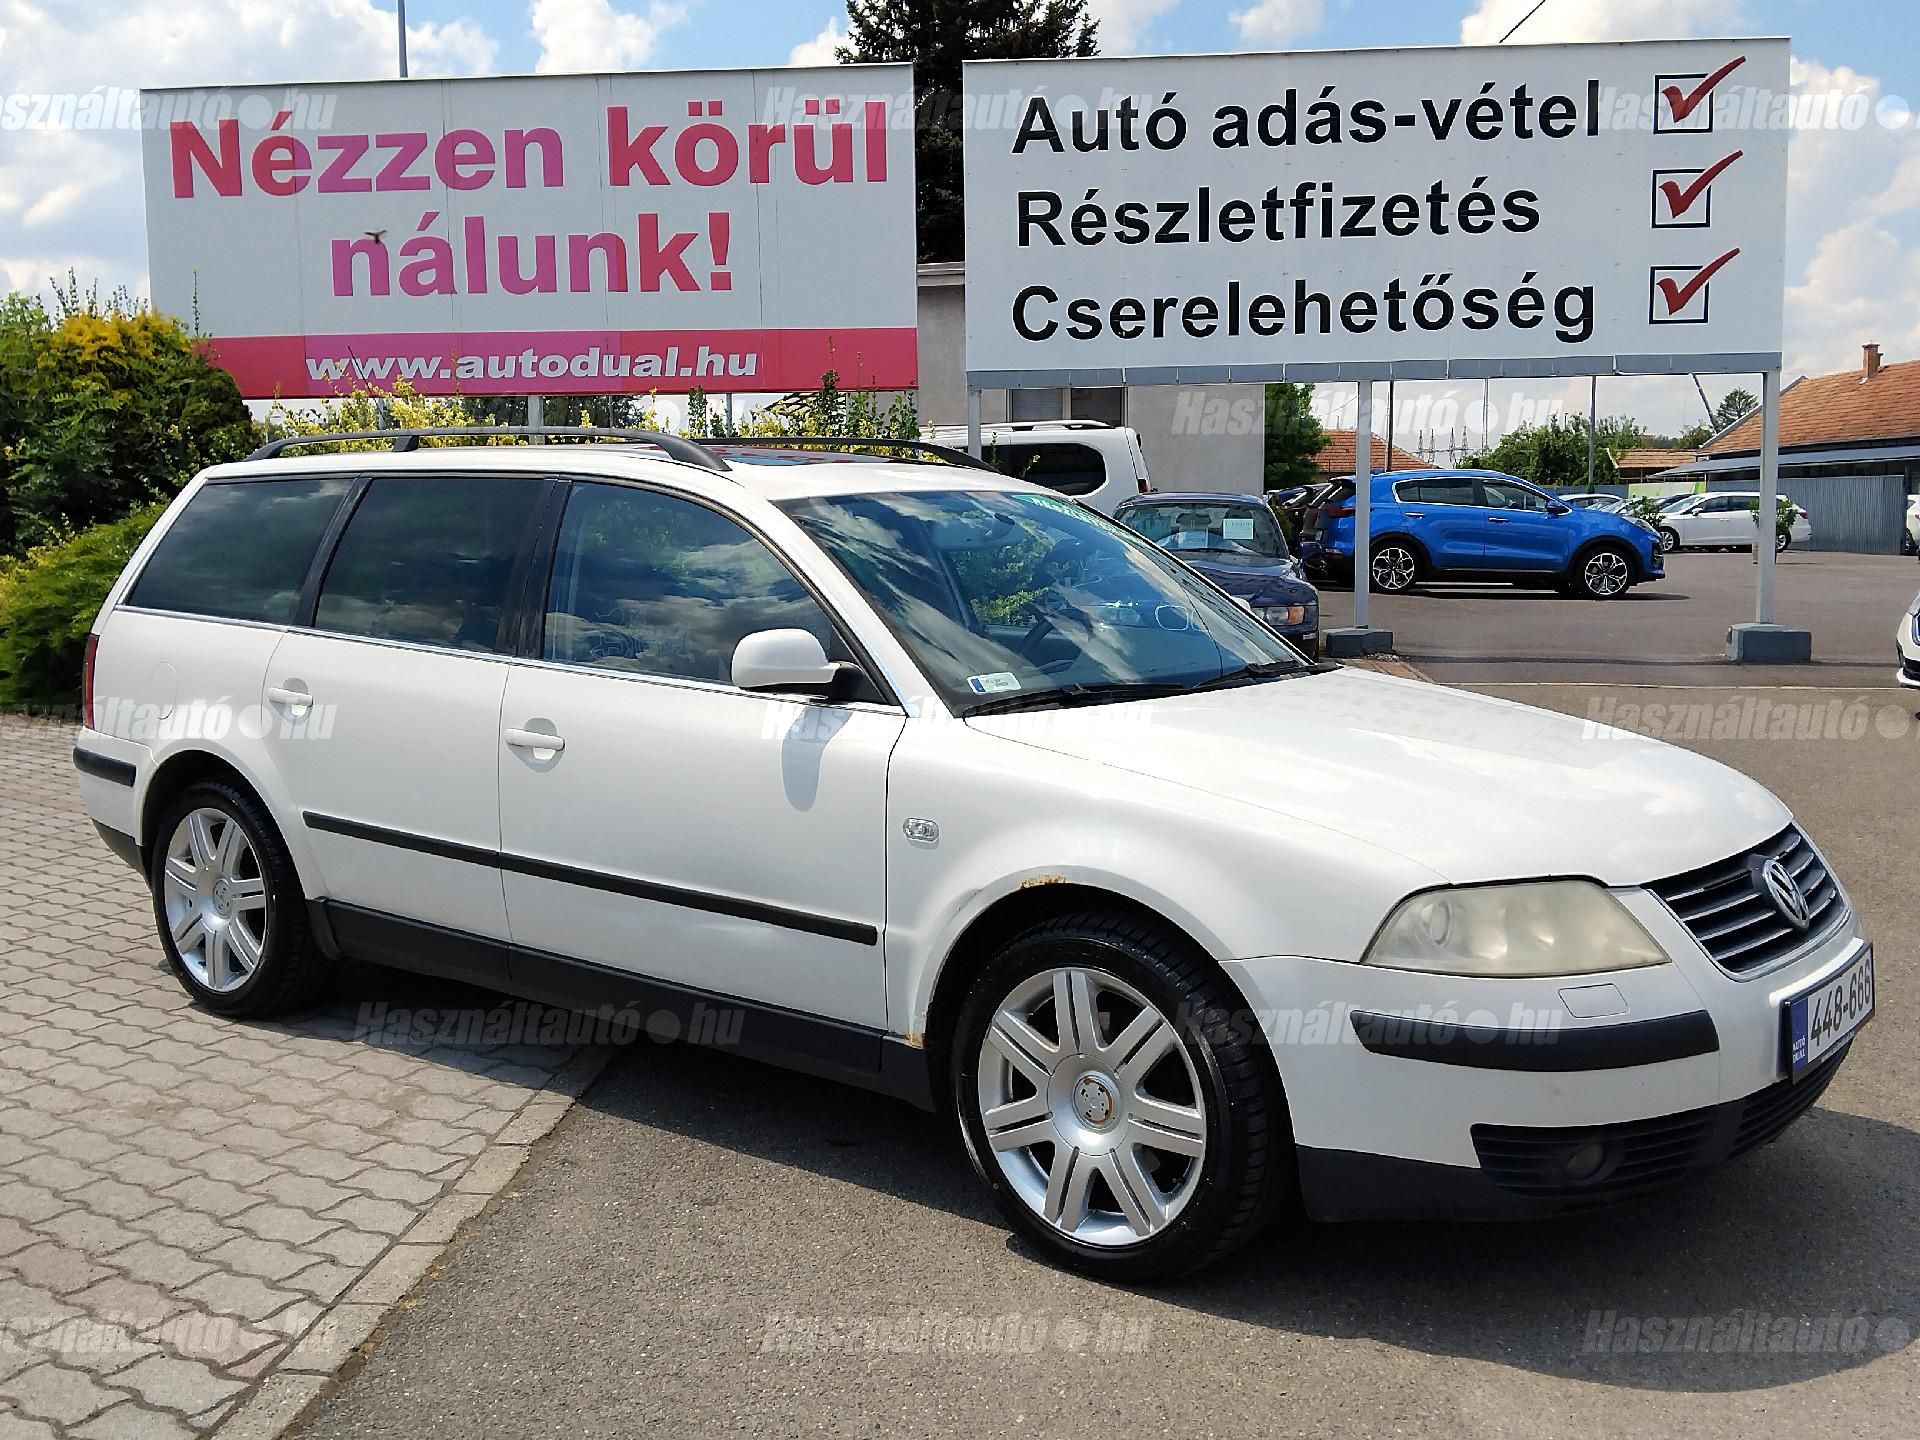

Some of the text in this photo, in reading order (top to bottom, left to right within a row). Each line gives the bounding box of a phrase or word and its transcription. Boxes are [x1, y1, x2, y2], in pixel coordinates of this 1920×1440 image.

[170, 99, 887, 199] Nézzen körül
[1011, 79, 1600, 154] Autó adás-vétel
[1017, 175, 1540, 247] Részletfizetés
[331, 211, 732, 297] nálunk!
[1012, 271, 1595, 344] Cserelehetőség
[305, 345, 757, 381] www.autodual.hu
[1810, 958, 1872, 1048] 448-666
